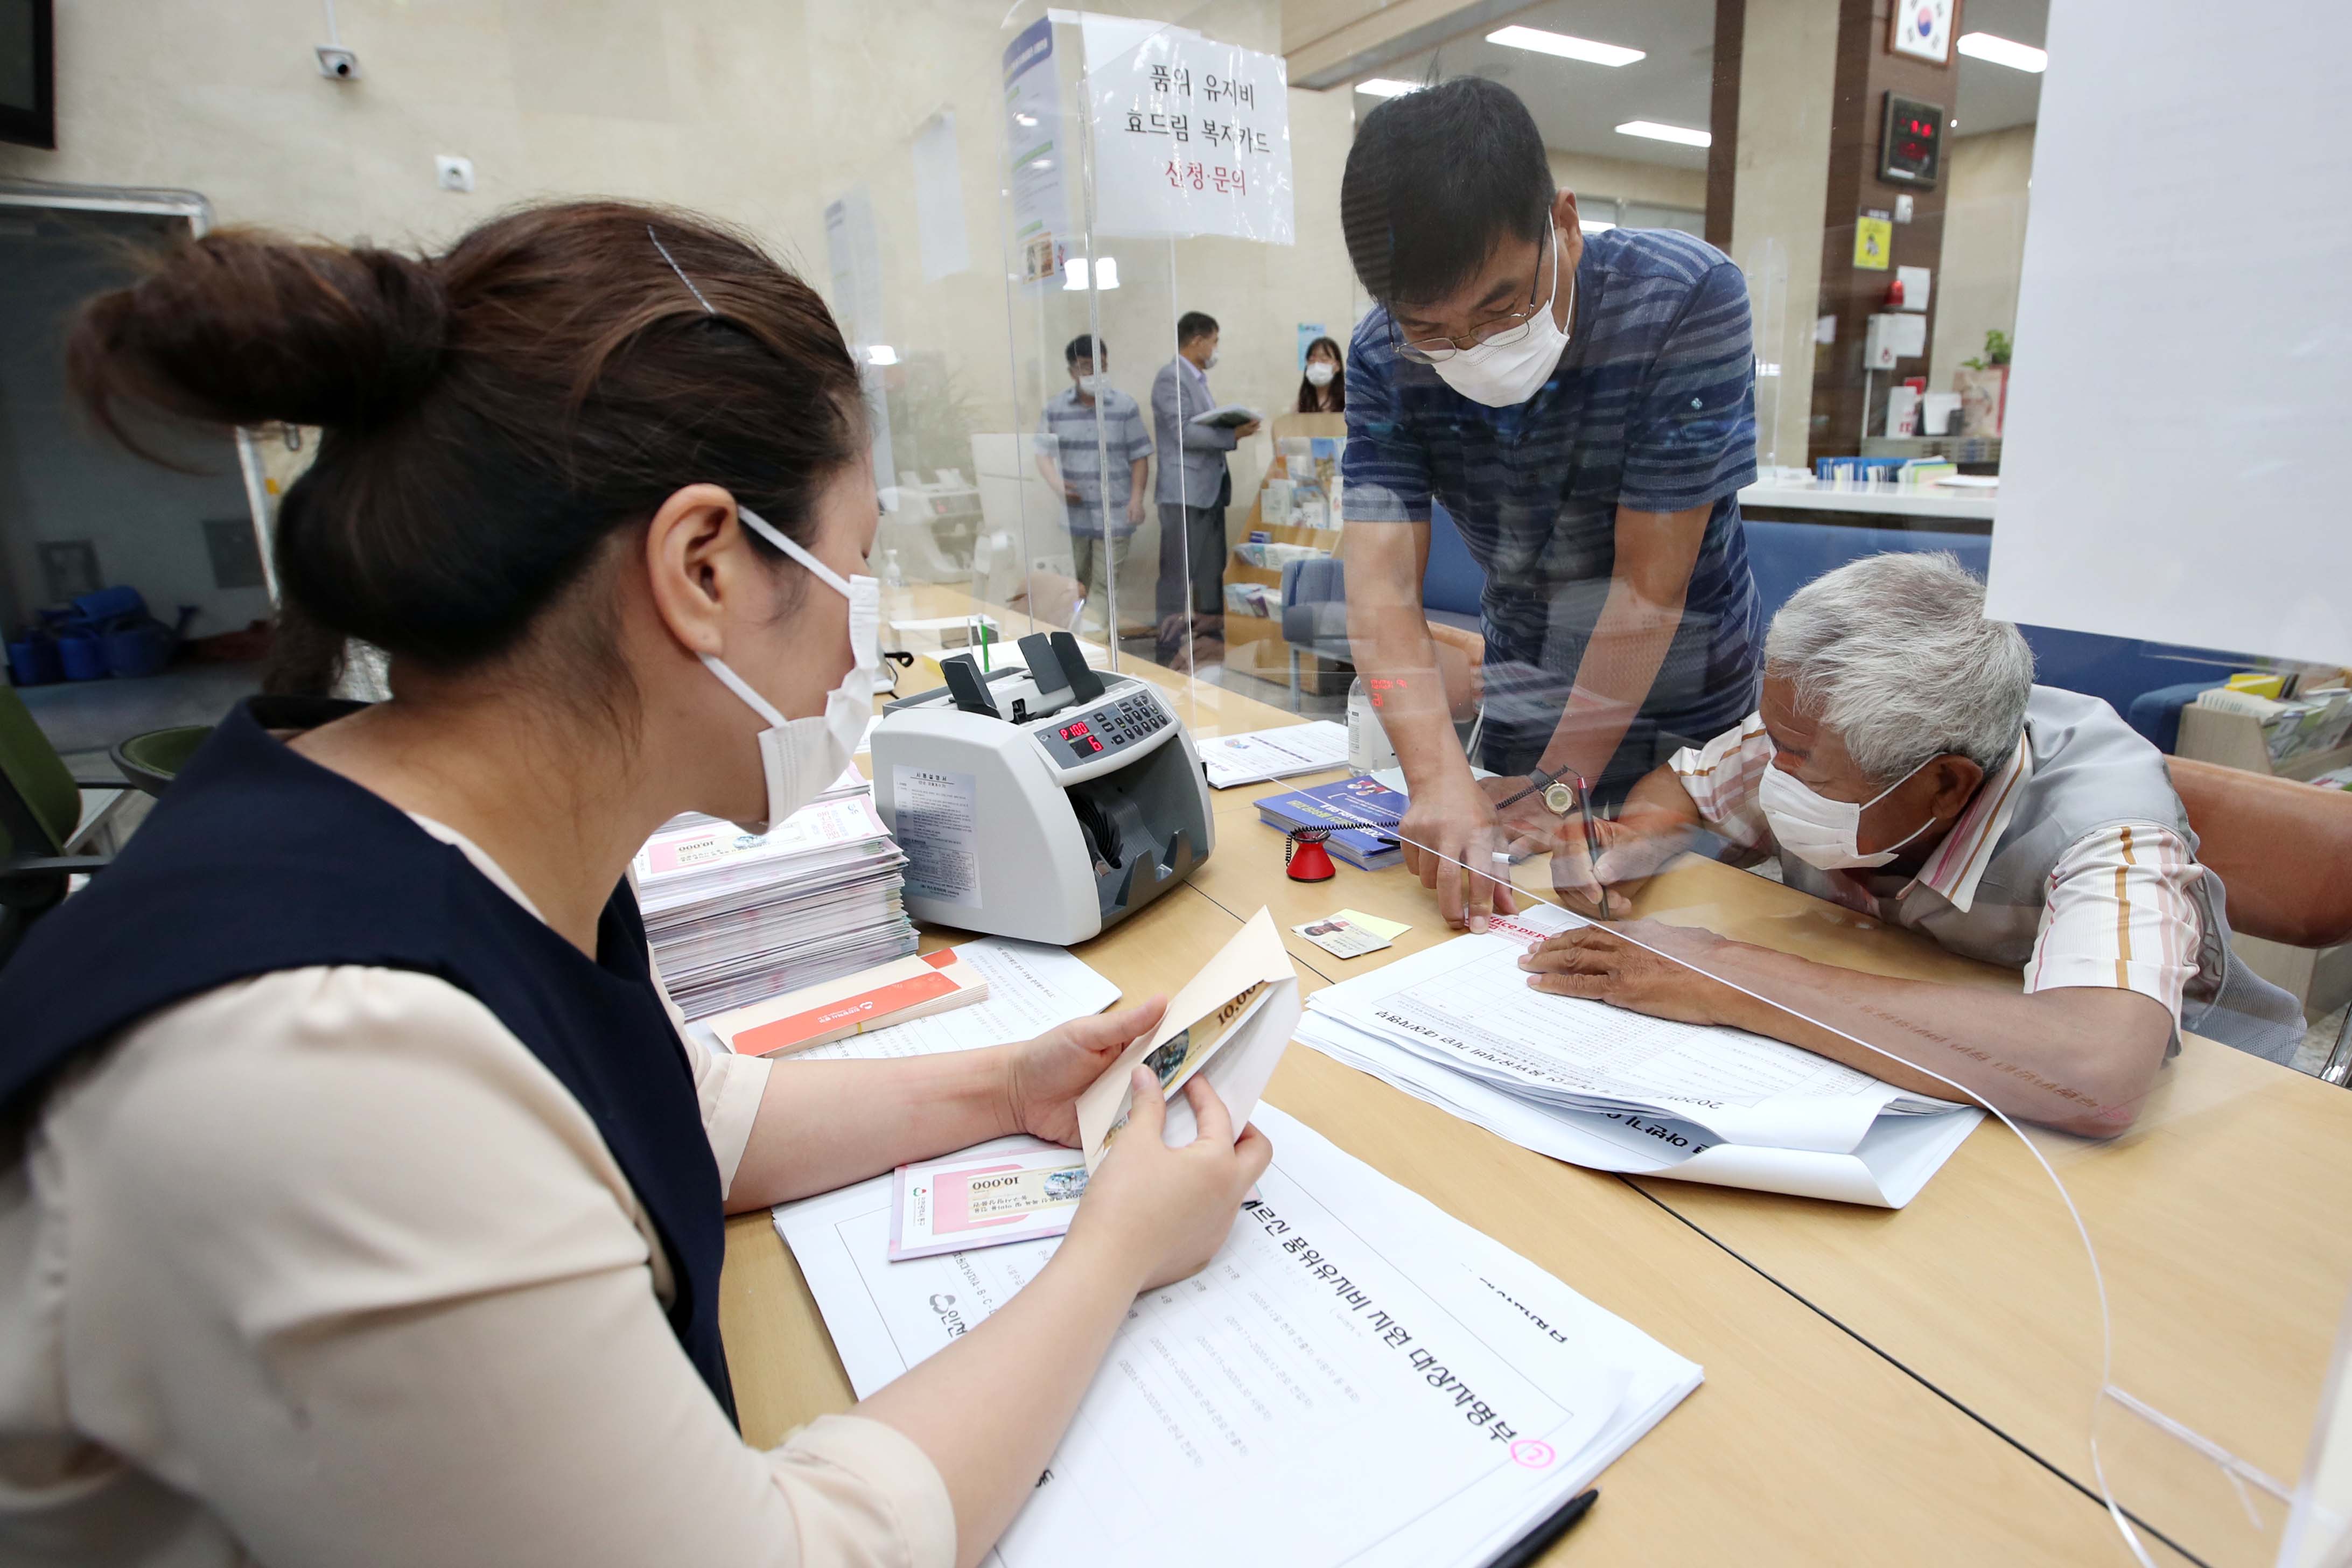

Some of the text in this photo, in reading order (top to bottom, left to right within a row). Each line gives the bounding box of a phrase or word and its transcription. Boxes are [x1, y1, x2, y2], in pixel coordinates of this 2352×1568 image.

[1150, 64, 1254, 110] 품위 유지비
[1124, 108, 1270, 154] 효드림 복지카드
[1217, 981, 1263, 1026] 10,00
[1623, 1116, 1689, 1147] 하반기
[972, 1176, 1019, 1191] 10,000
[1282, 1236, 1372, 1312] 품위유지비
[1367, 1310, 1413, 1349] 지원
[1408, 1348, 1517, 1444] 대상자명부
